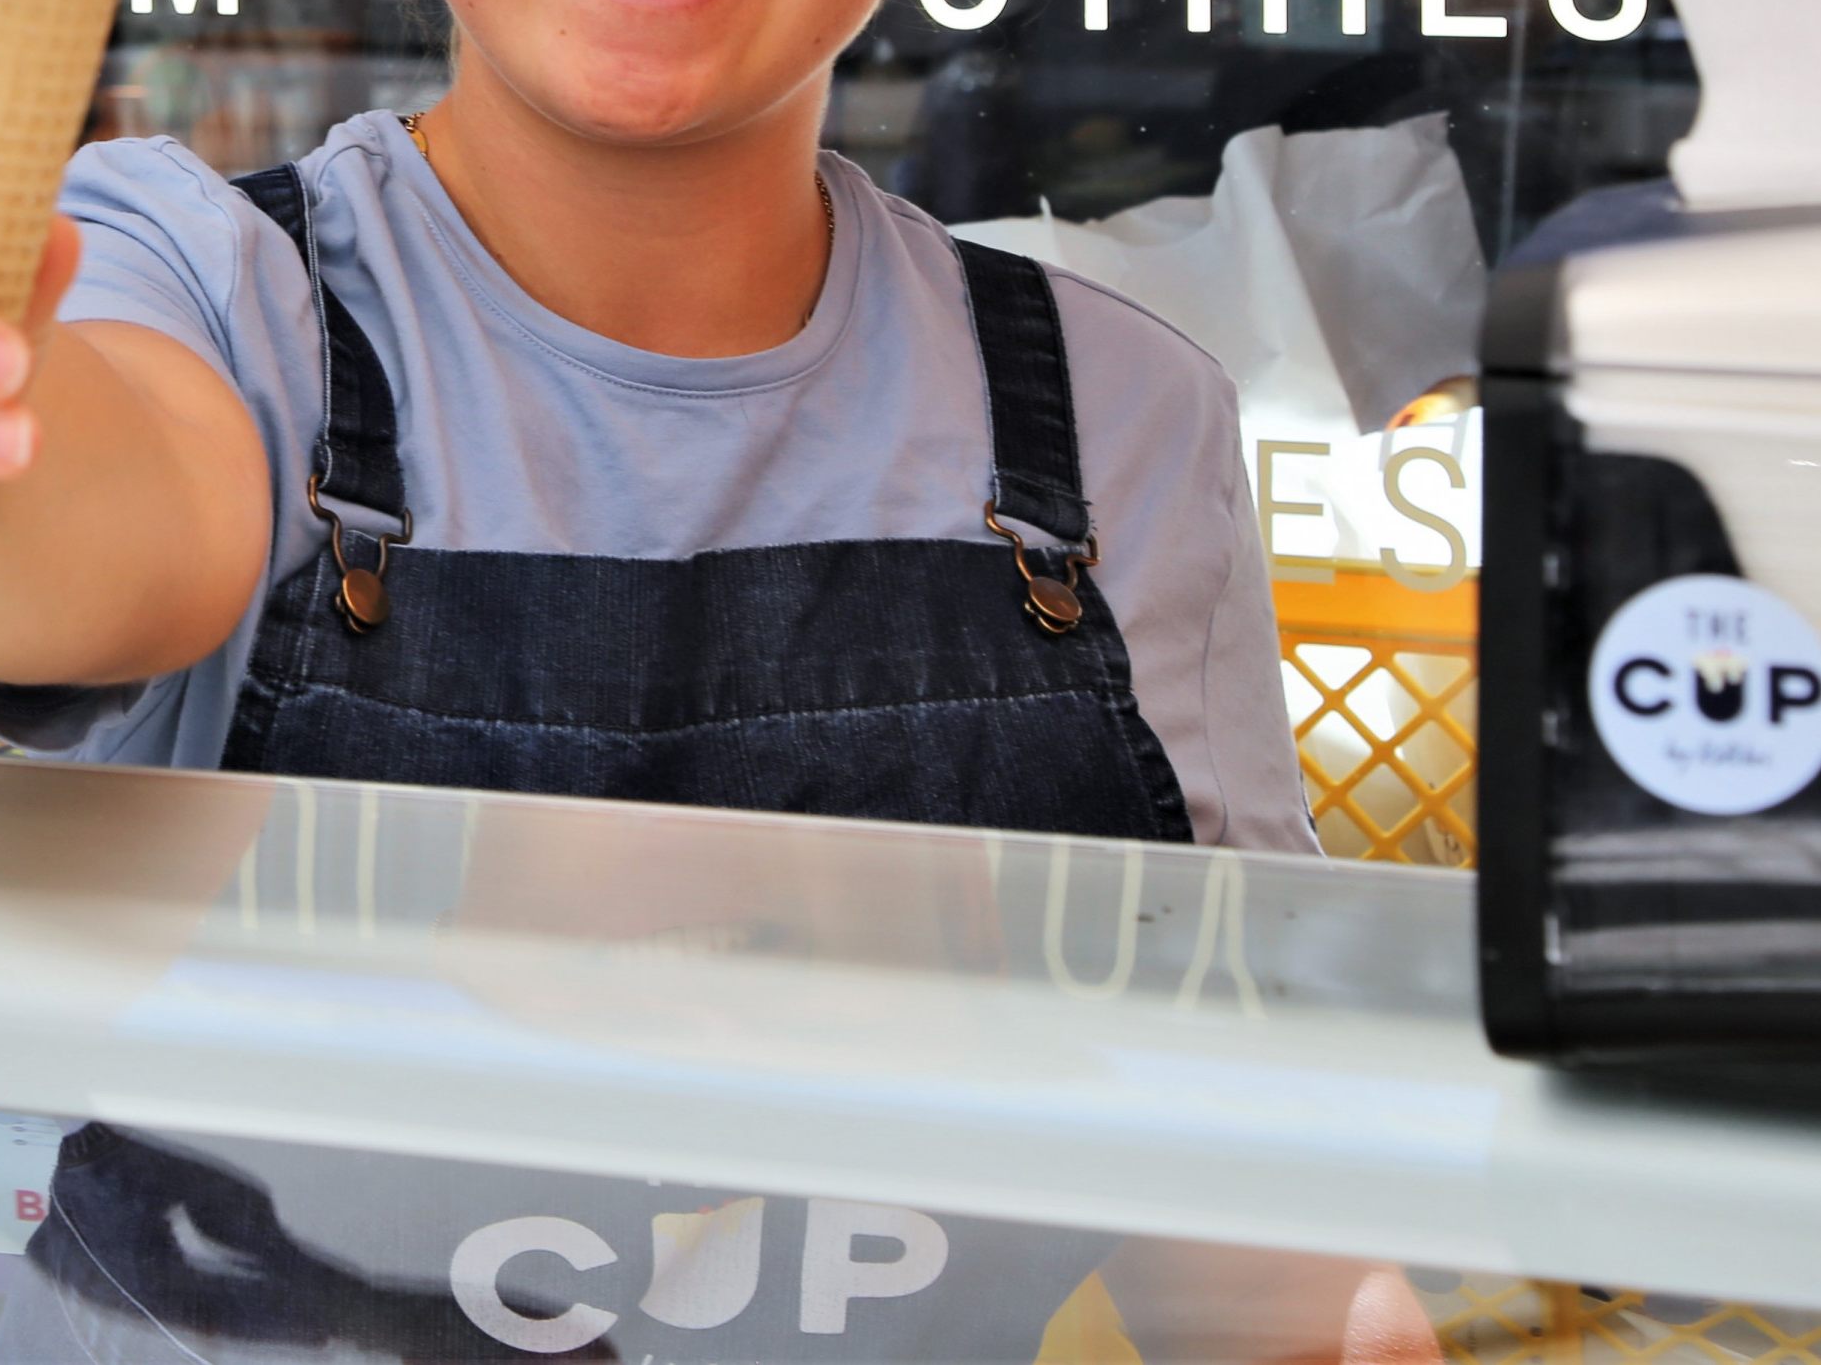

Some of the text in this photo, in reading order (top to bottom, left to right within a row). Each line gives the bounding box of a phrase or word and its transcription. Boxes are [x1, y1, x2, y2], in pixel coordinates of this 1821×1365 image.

[1255, 439, 1468, 593] ES
[1614, 655, 1821, 726] CUP
[450, 1196, 949, 1354] CUP
